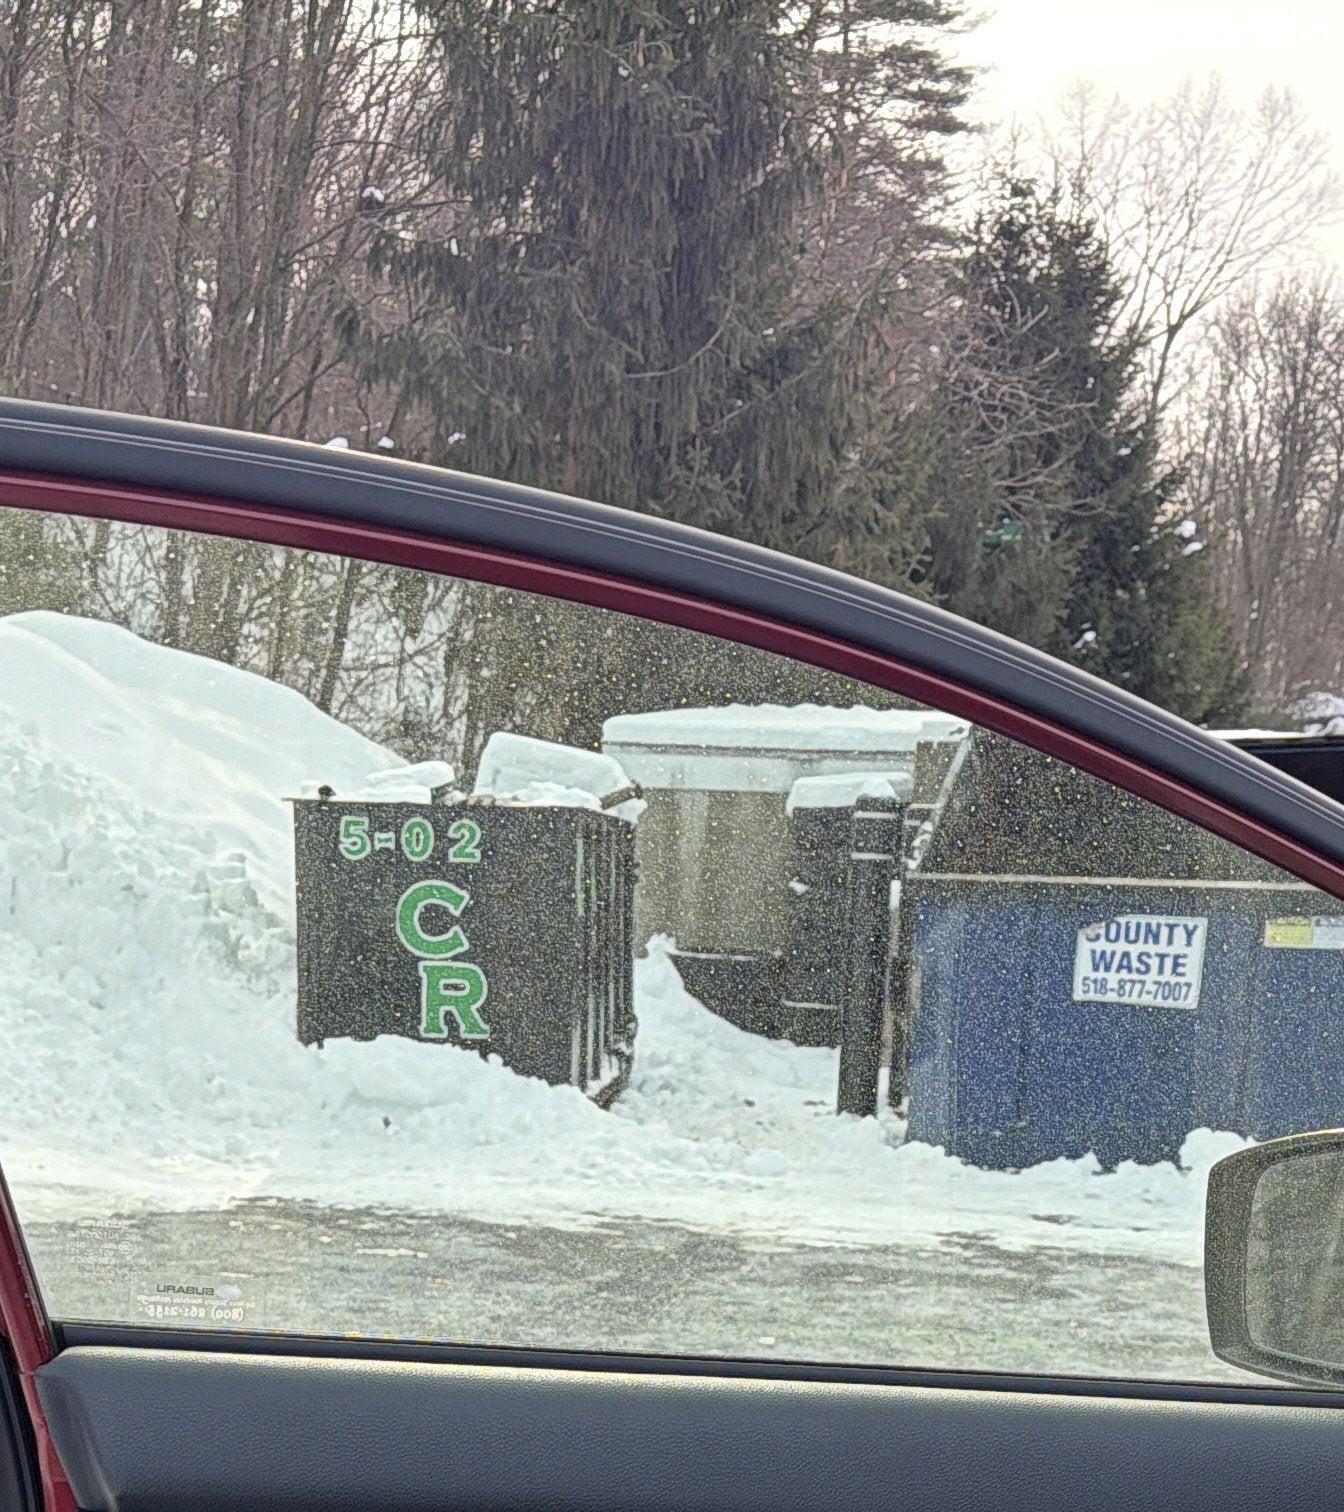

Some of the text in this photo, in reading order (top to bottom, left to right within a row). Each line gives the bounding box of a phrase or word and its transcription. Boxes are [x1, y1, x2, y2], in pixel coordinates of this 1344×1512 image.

[396, 880, 470, 958] C
[1081, 976, 1192, 1002] 518-877-7007
[1090, 949, 1188, 977] WASTE
[419, 961, 490, 1038] R
